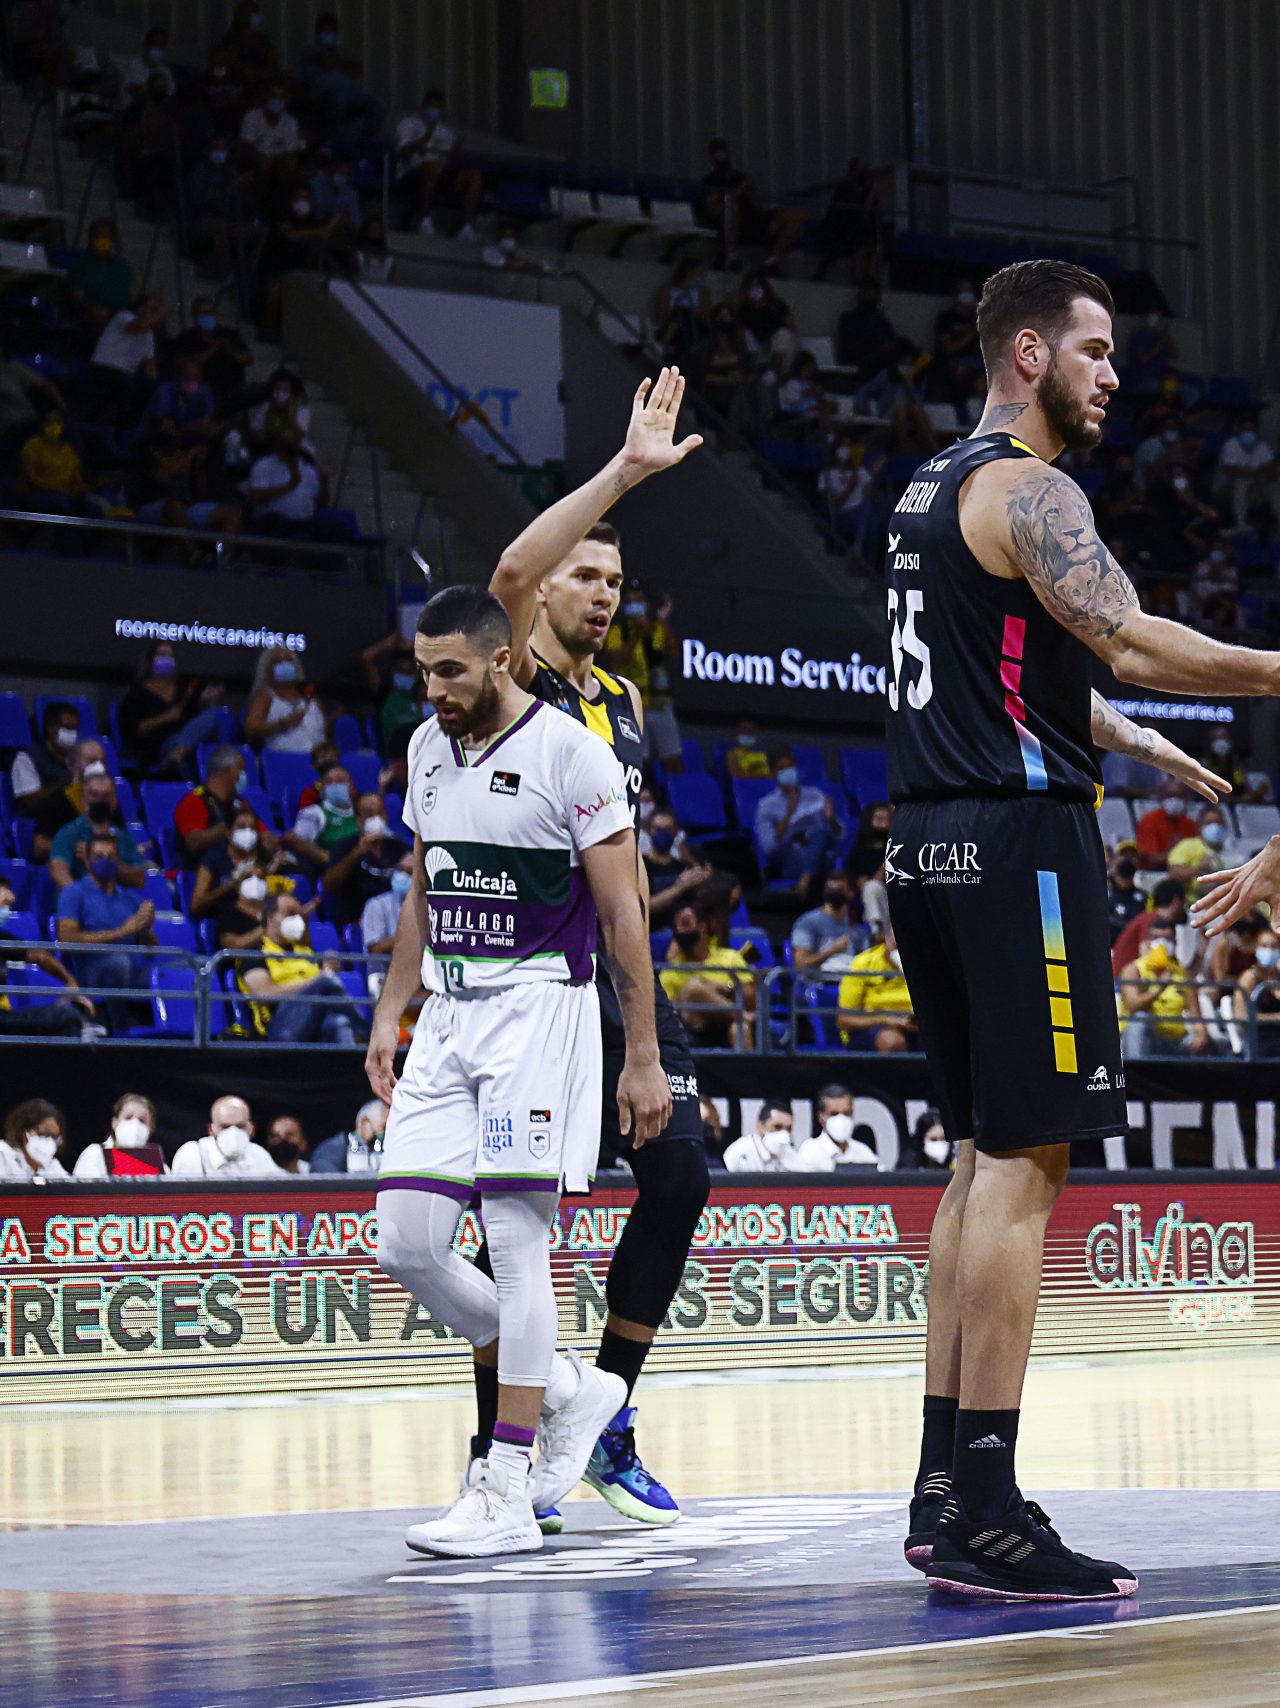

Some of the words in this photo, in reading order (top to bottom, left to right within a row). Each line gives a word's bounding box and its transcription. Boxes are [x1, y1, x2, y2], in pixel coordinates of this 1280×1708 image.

[682, 639, 774, 686] Room
[918, 842, 982, 872] CICAR
[452, 869, 517, 896] Unicaja
[963, 873, 982, 884] Car
[441, 905, 515, 932] MÁLAGA
[46, 1213, 236, 1264] SEGUROS
[243, 1211, 305, 1260] EN
[308, 1209, 378, 1260] APO
[790, 1203, 898, 1245] LANZA
[0, 1273, 245, 1358] RECES
[270, 1270, 372, 1345] UN
[730, 1256, 930, 1328] SEGUR
